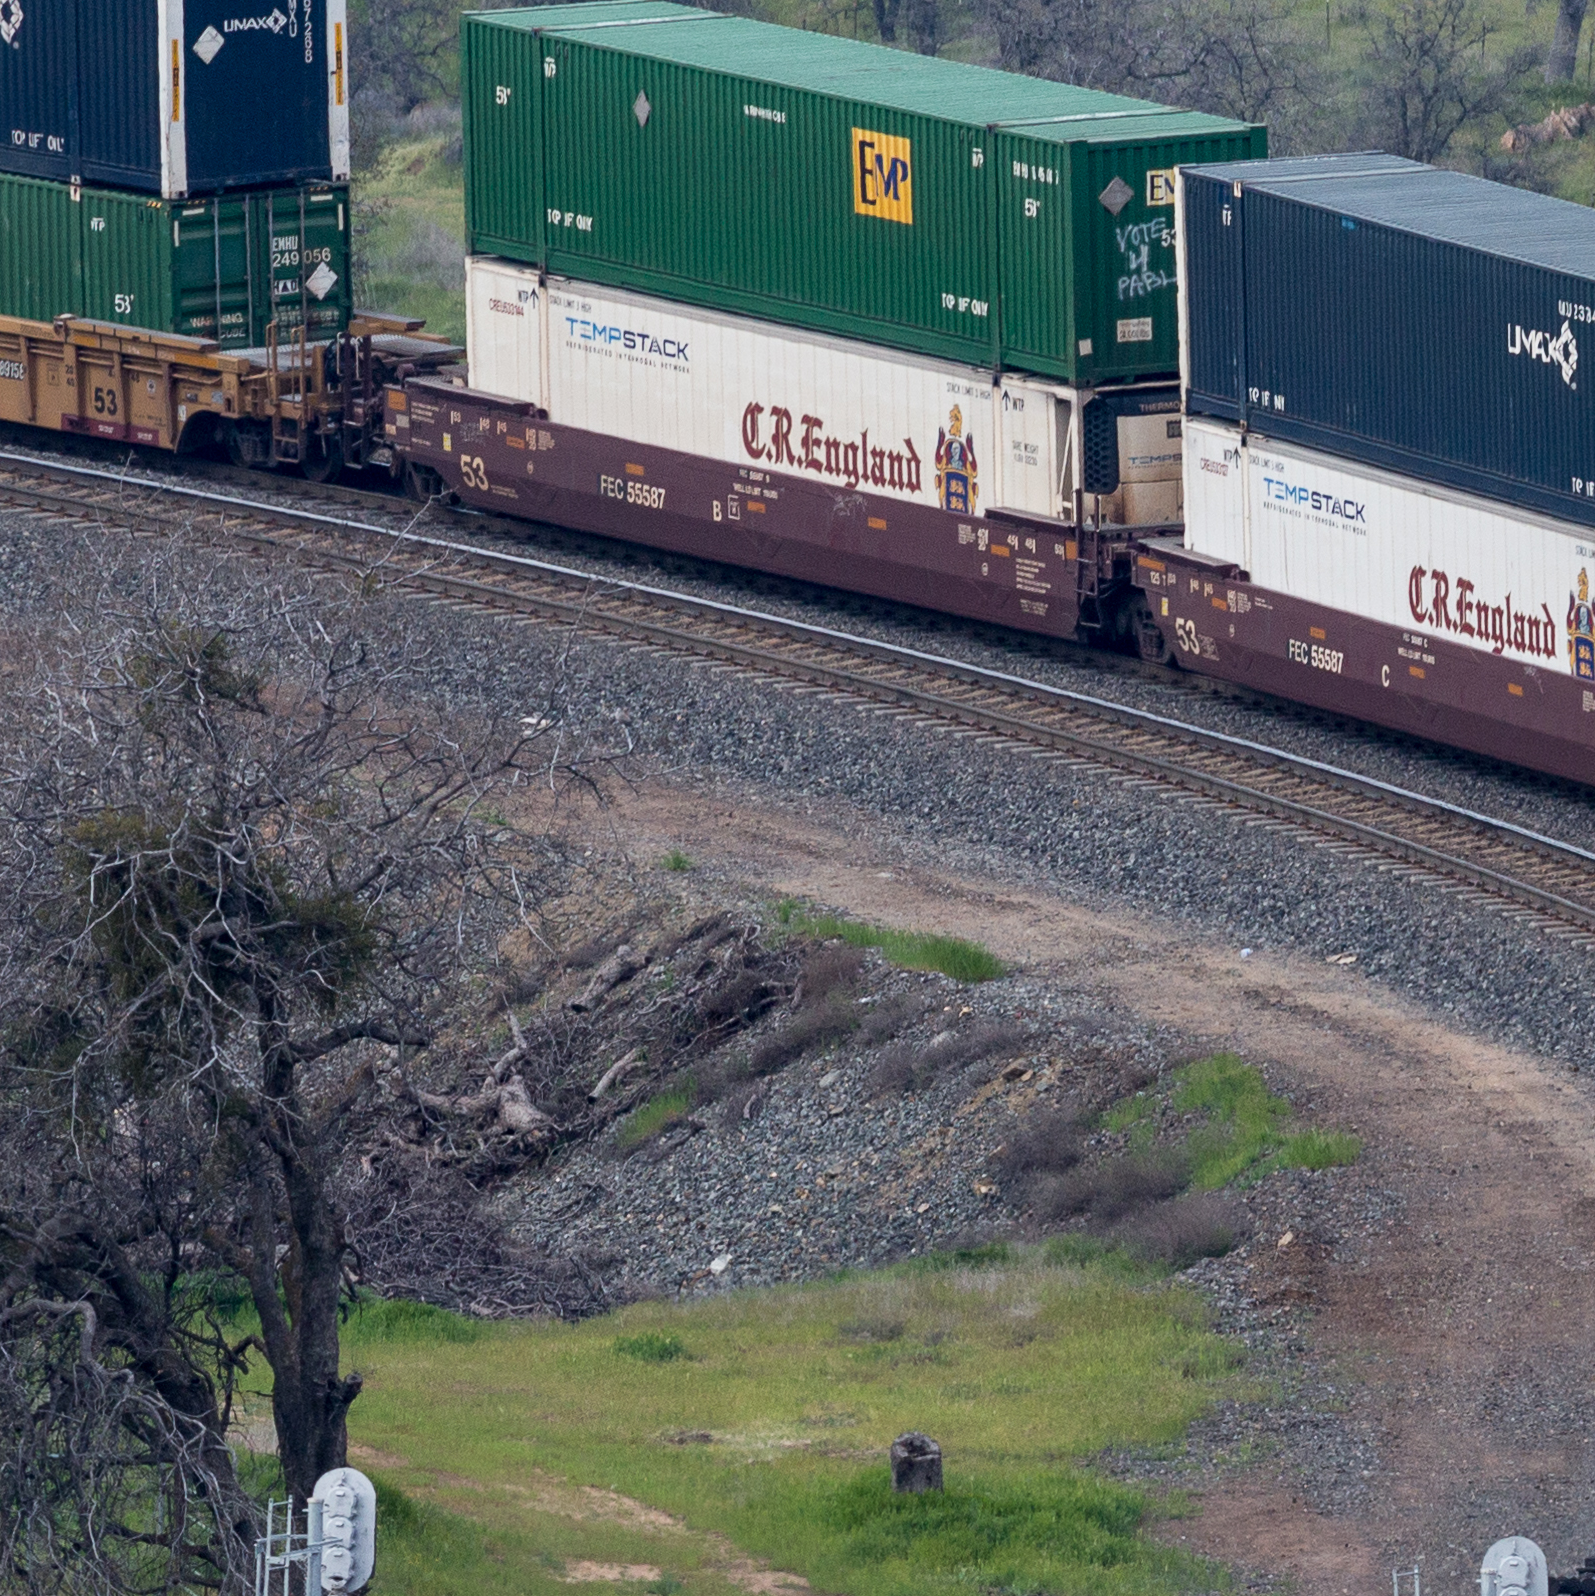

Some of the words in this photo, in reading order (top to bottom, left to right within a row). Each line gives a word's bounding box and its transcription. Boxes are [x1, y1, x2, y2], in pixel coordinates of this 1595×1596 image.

[224, 16, 267, 32] UMAX
[859, 140, 908, 206] EMP
[1116, 217, 1166, 252] VOTE
[1118, 269, 1177, 300] PABL
[190, 312, 244, 328] WARING
[565, 317, 689, 361] TEMPSTACK
[94, 387, 118, 416] 53
[460, 454, 489, 491] 53
[600, 475, 624, 500] FEC
[627, 481, 666, 510] 55587
[1263, 477, 1366, 523] TEMPSTACK
[713, 500, 722, 521] B
[1175, 617, 1201, 655] 53
[1289, 639, 1309, 664] FEC
[1311, 644, 1344, 674] 55587
[1381, 664, 1390, 688] C
